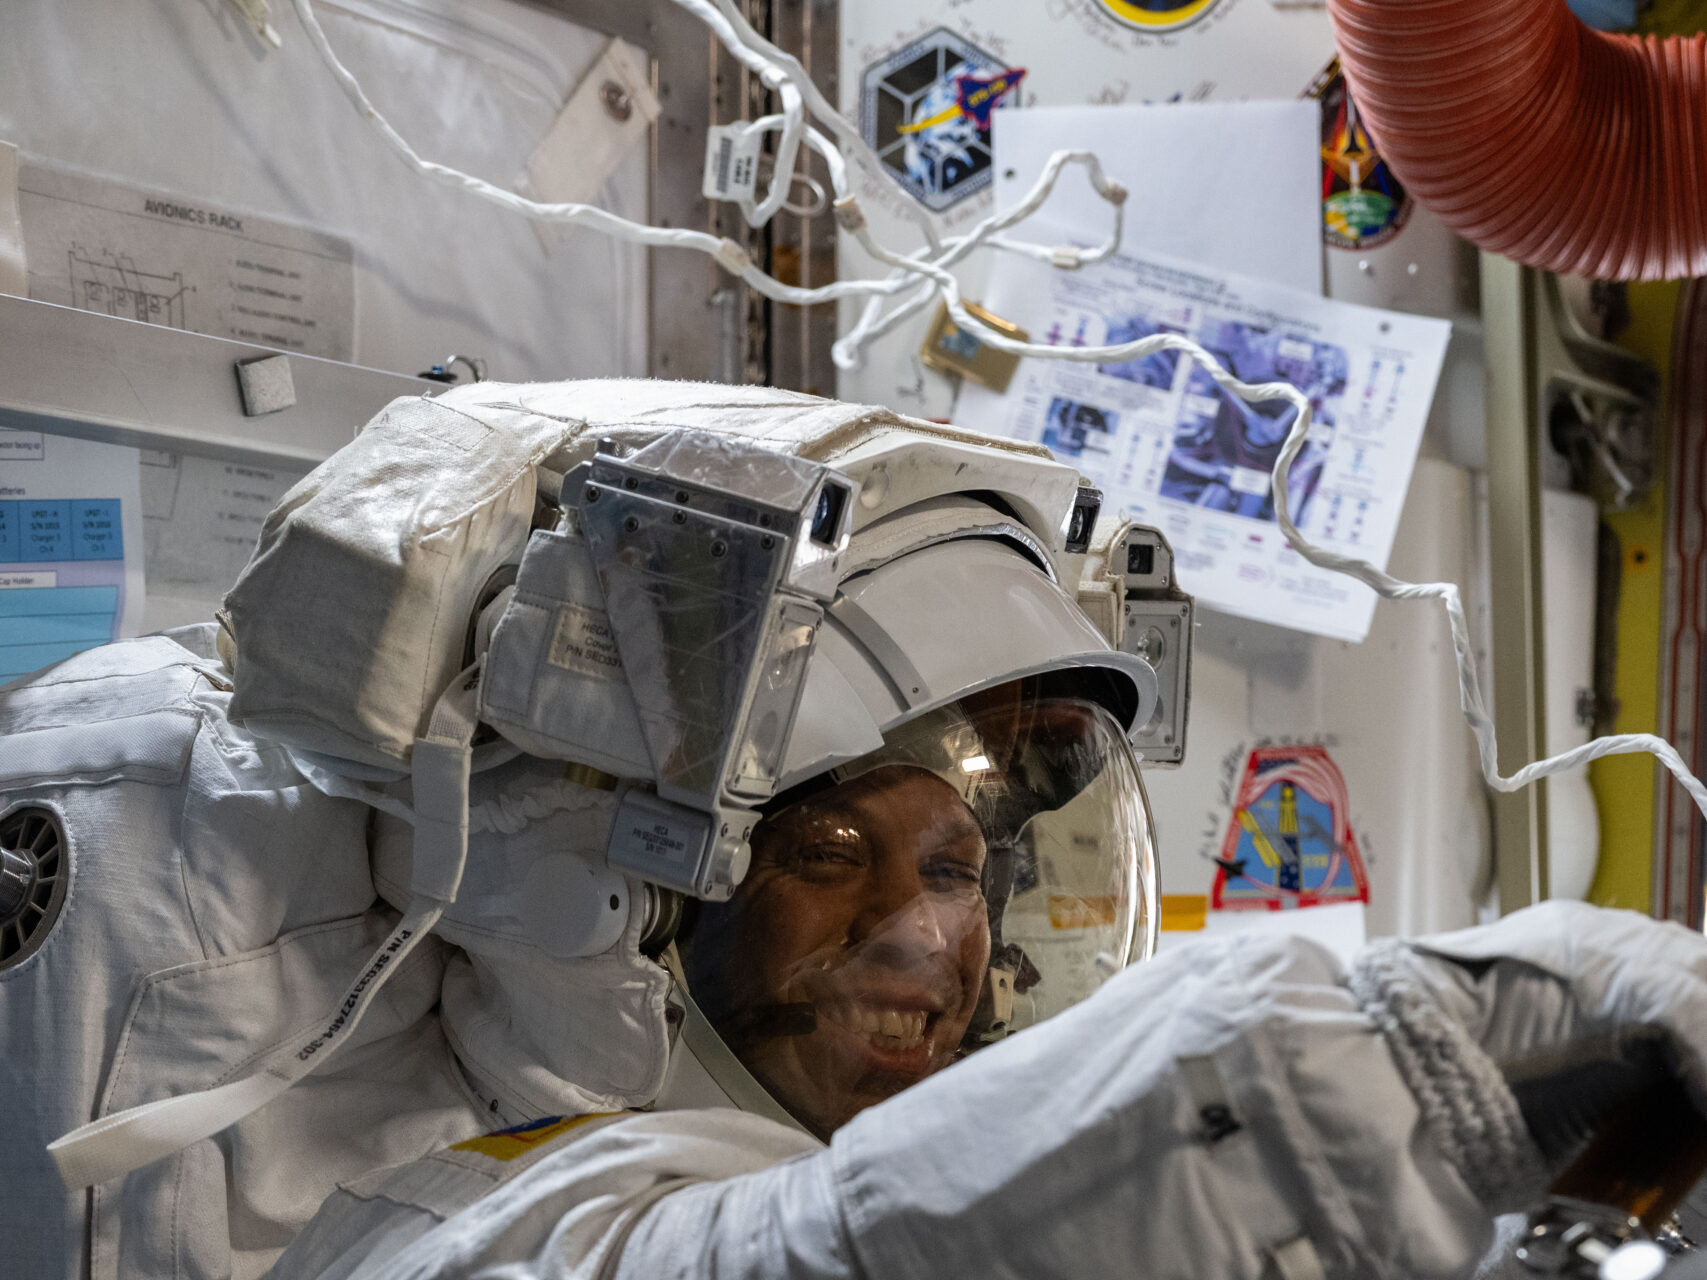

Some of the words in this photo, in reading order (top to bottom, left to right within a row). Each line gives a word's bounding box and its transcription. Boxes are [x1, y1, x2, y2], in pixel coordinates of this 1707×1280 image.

[144, 198, 206, 225] AVIONICS
[208, 212, 244, 233] RACK
[388, 929, 413, 953] P/N
